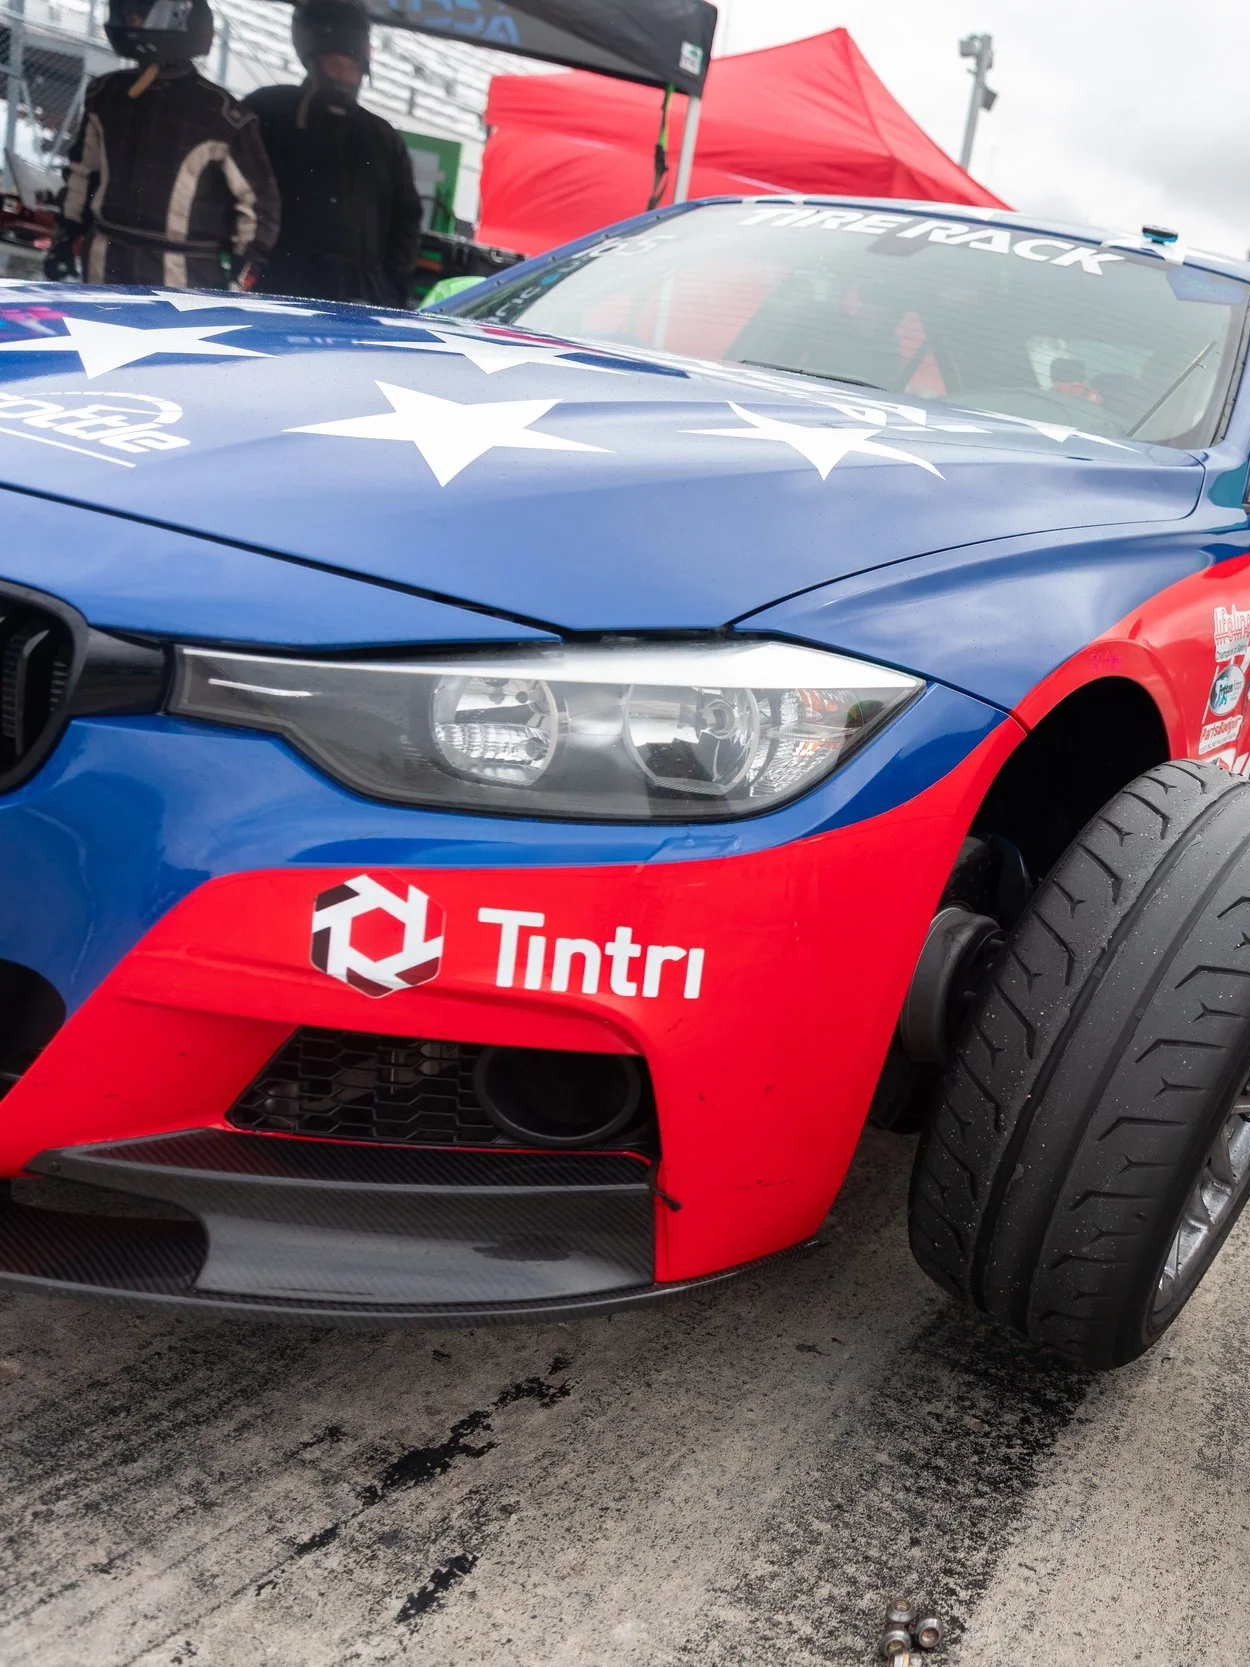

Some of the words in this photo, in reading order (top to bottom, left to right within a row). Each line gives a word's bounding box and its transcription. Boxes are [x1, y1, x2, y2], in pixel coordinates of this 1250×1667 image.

[738, 208, 914, 235] TIRE
[896, 220, 1127, 276] RACK
[0, 398, 191, 453] ottle
[477, 907, 705, 1000] Tintri
